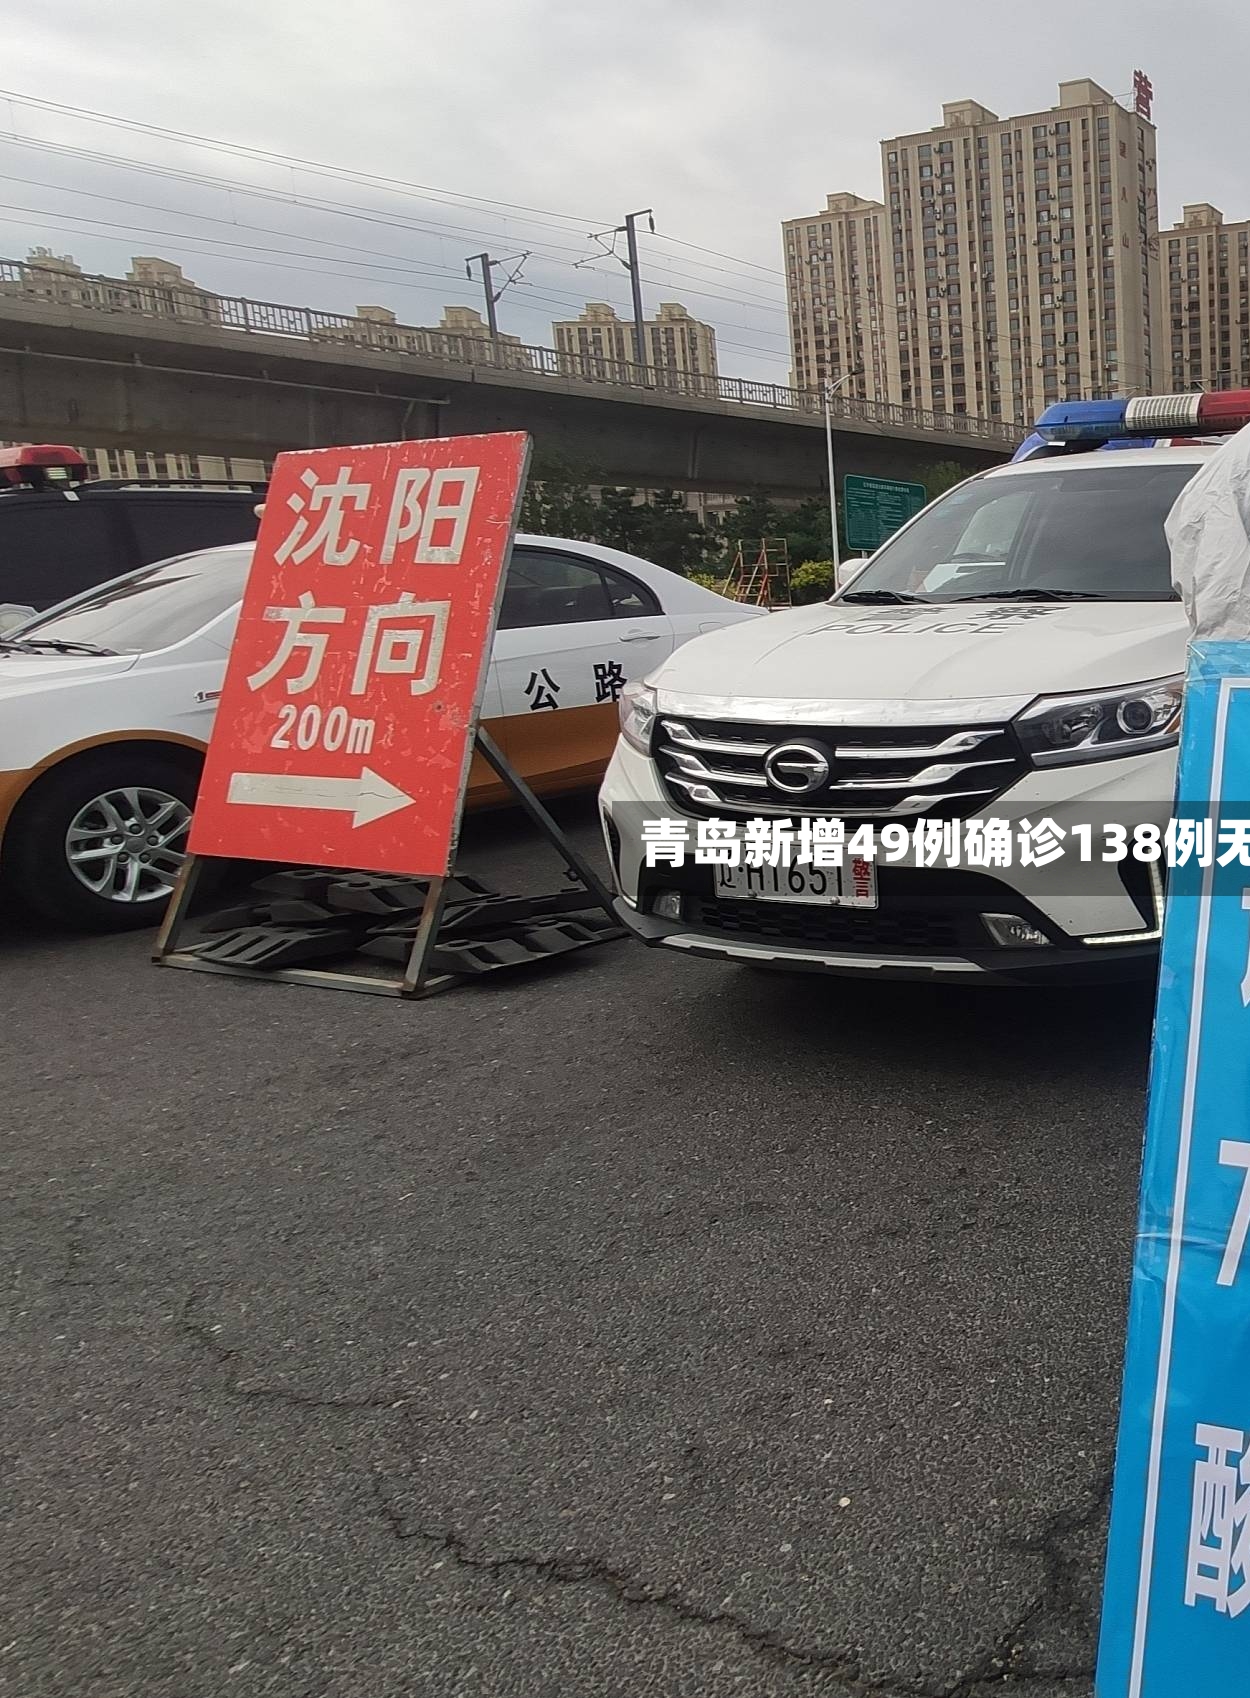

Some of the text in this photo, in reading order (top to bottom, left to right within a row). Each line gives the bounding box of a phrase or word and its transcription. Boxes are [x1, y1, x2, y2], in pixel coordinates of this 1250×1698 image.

[273, 465, 481, 568] 沈阳
[246, 590, 446, 698] 方向
[807, 622, 1026, 635] POLICE
[524, 660, 627, 711] 公路
[270, 704, 376, 755] 200m
